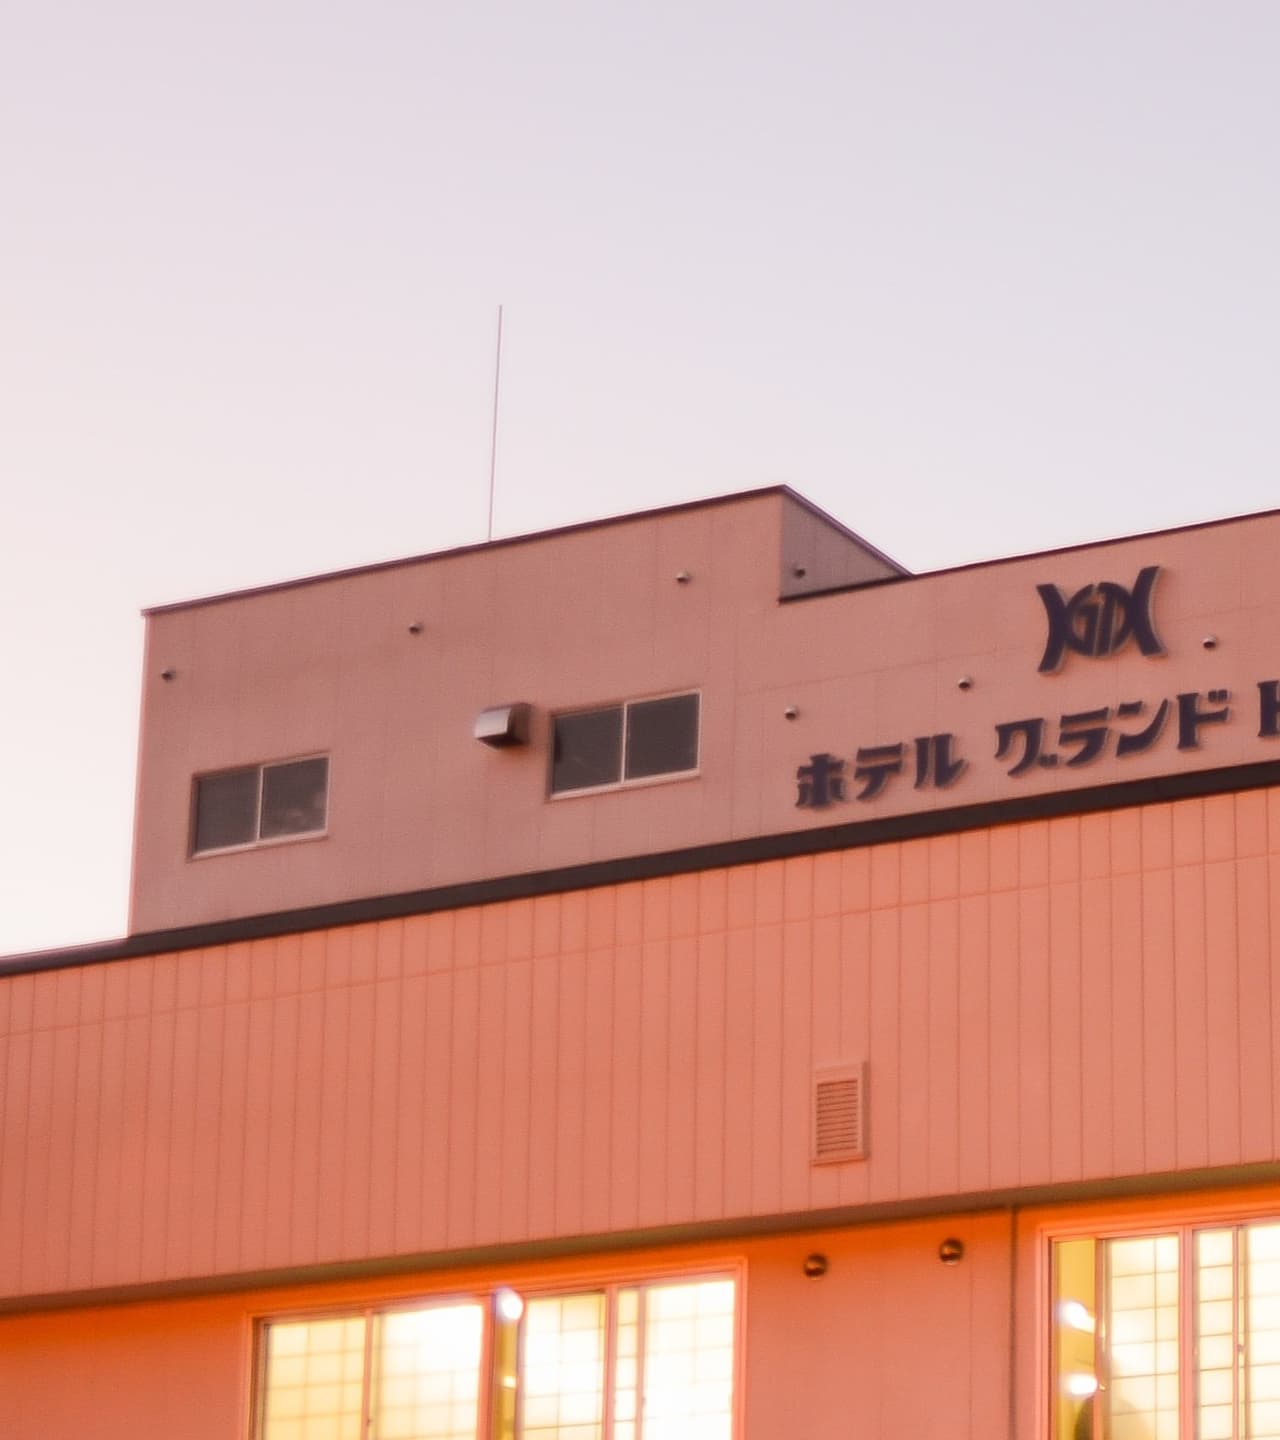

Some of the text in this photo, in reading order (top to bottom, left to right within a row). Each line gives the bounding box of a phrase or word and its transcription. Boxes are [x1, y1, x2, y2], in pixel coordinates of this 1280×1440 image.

[795, 733, 966, 808] ホテル
[994, 689, 1229, 775] グランド
